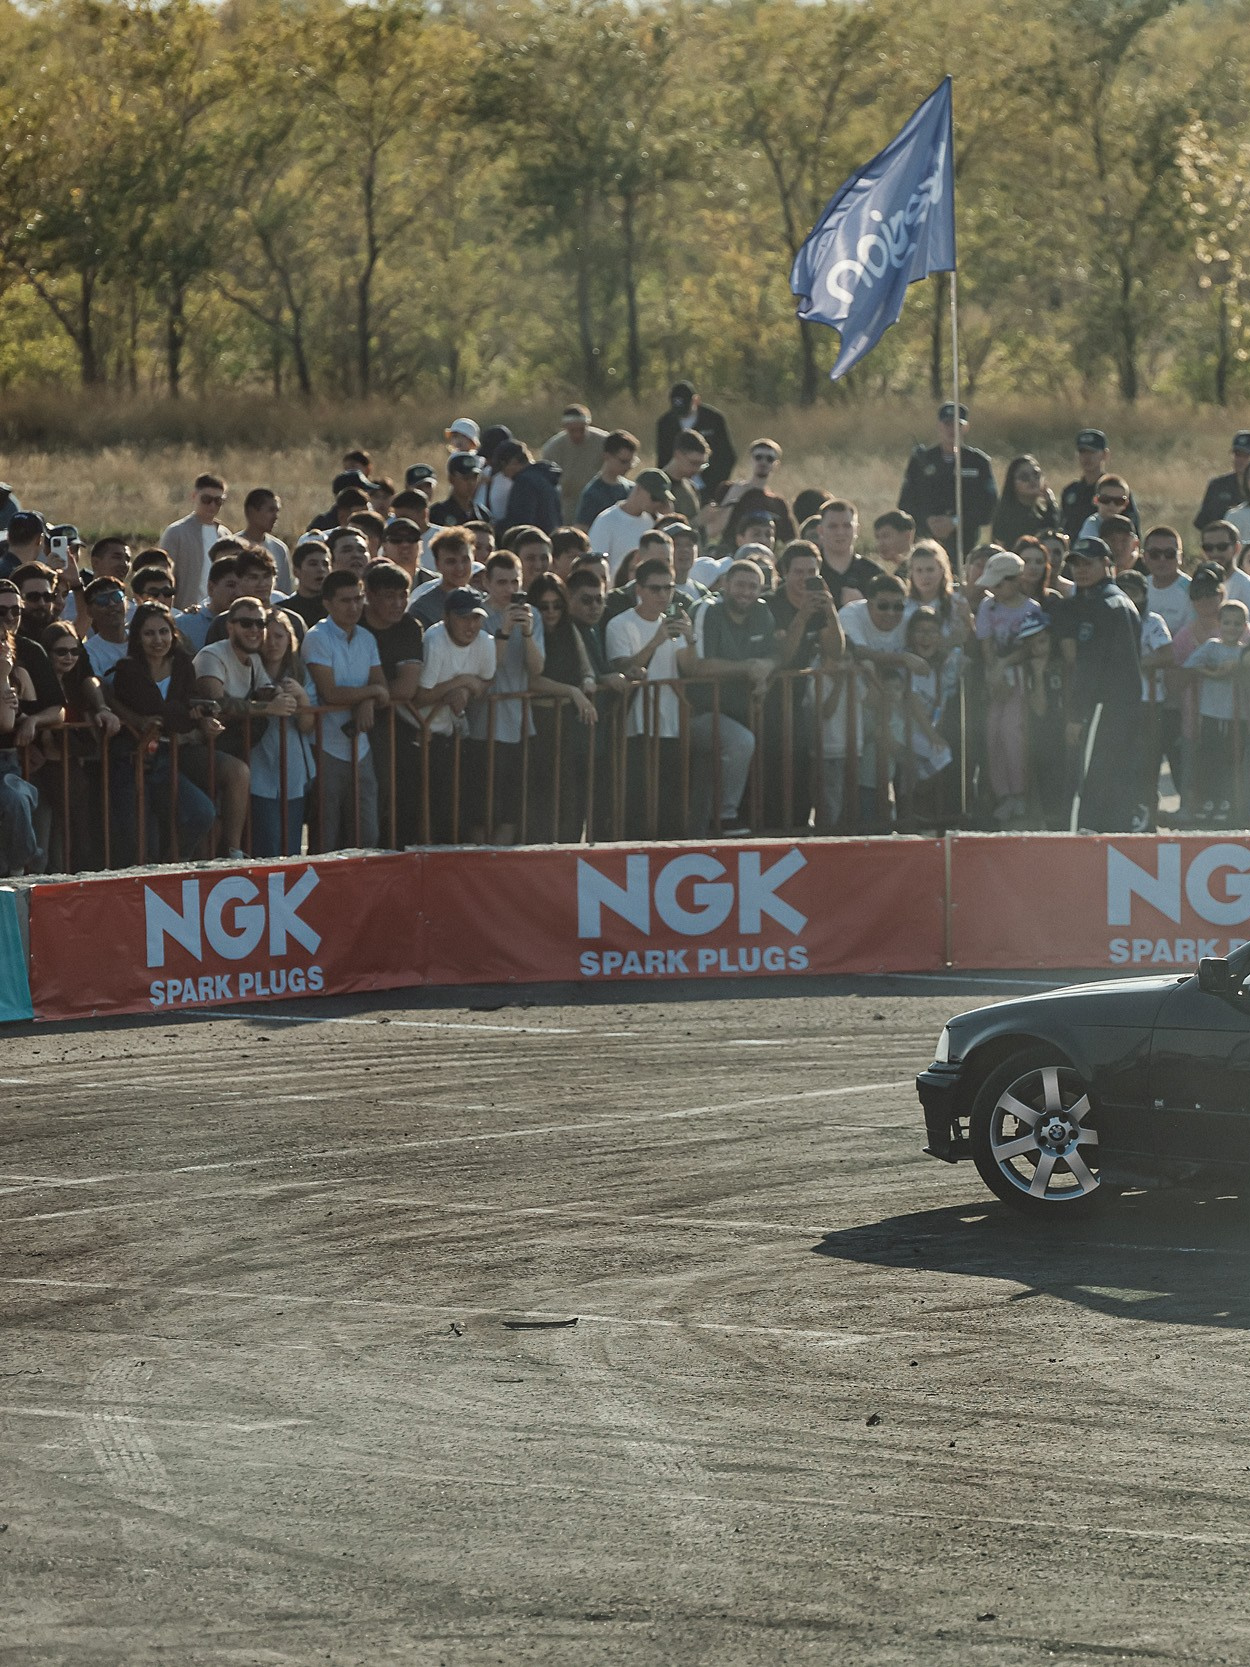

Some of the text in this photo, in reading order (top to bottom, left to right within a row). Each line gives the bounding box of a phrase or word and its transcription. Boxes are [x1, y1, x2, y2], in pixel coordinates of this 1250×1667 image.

[577, 848, 808, 938] NGK
[145, 867, 322, 968] NGK
[579, 946, 809, 976] SPARK PLUGS
[1109, 939, 1219, 964] SPARK
[150, 966, 324, 1006] SPARK PLUGS
